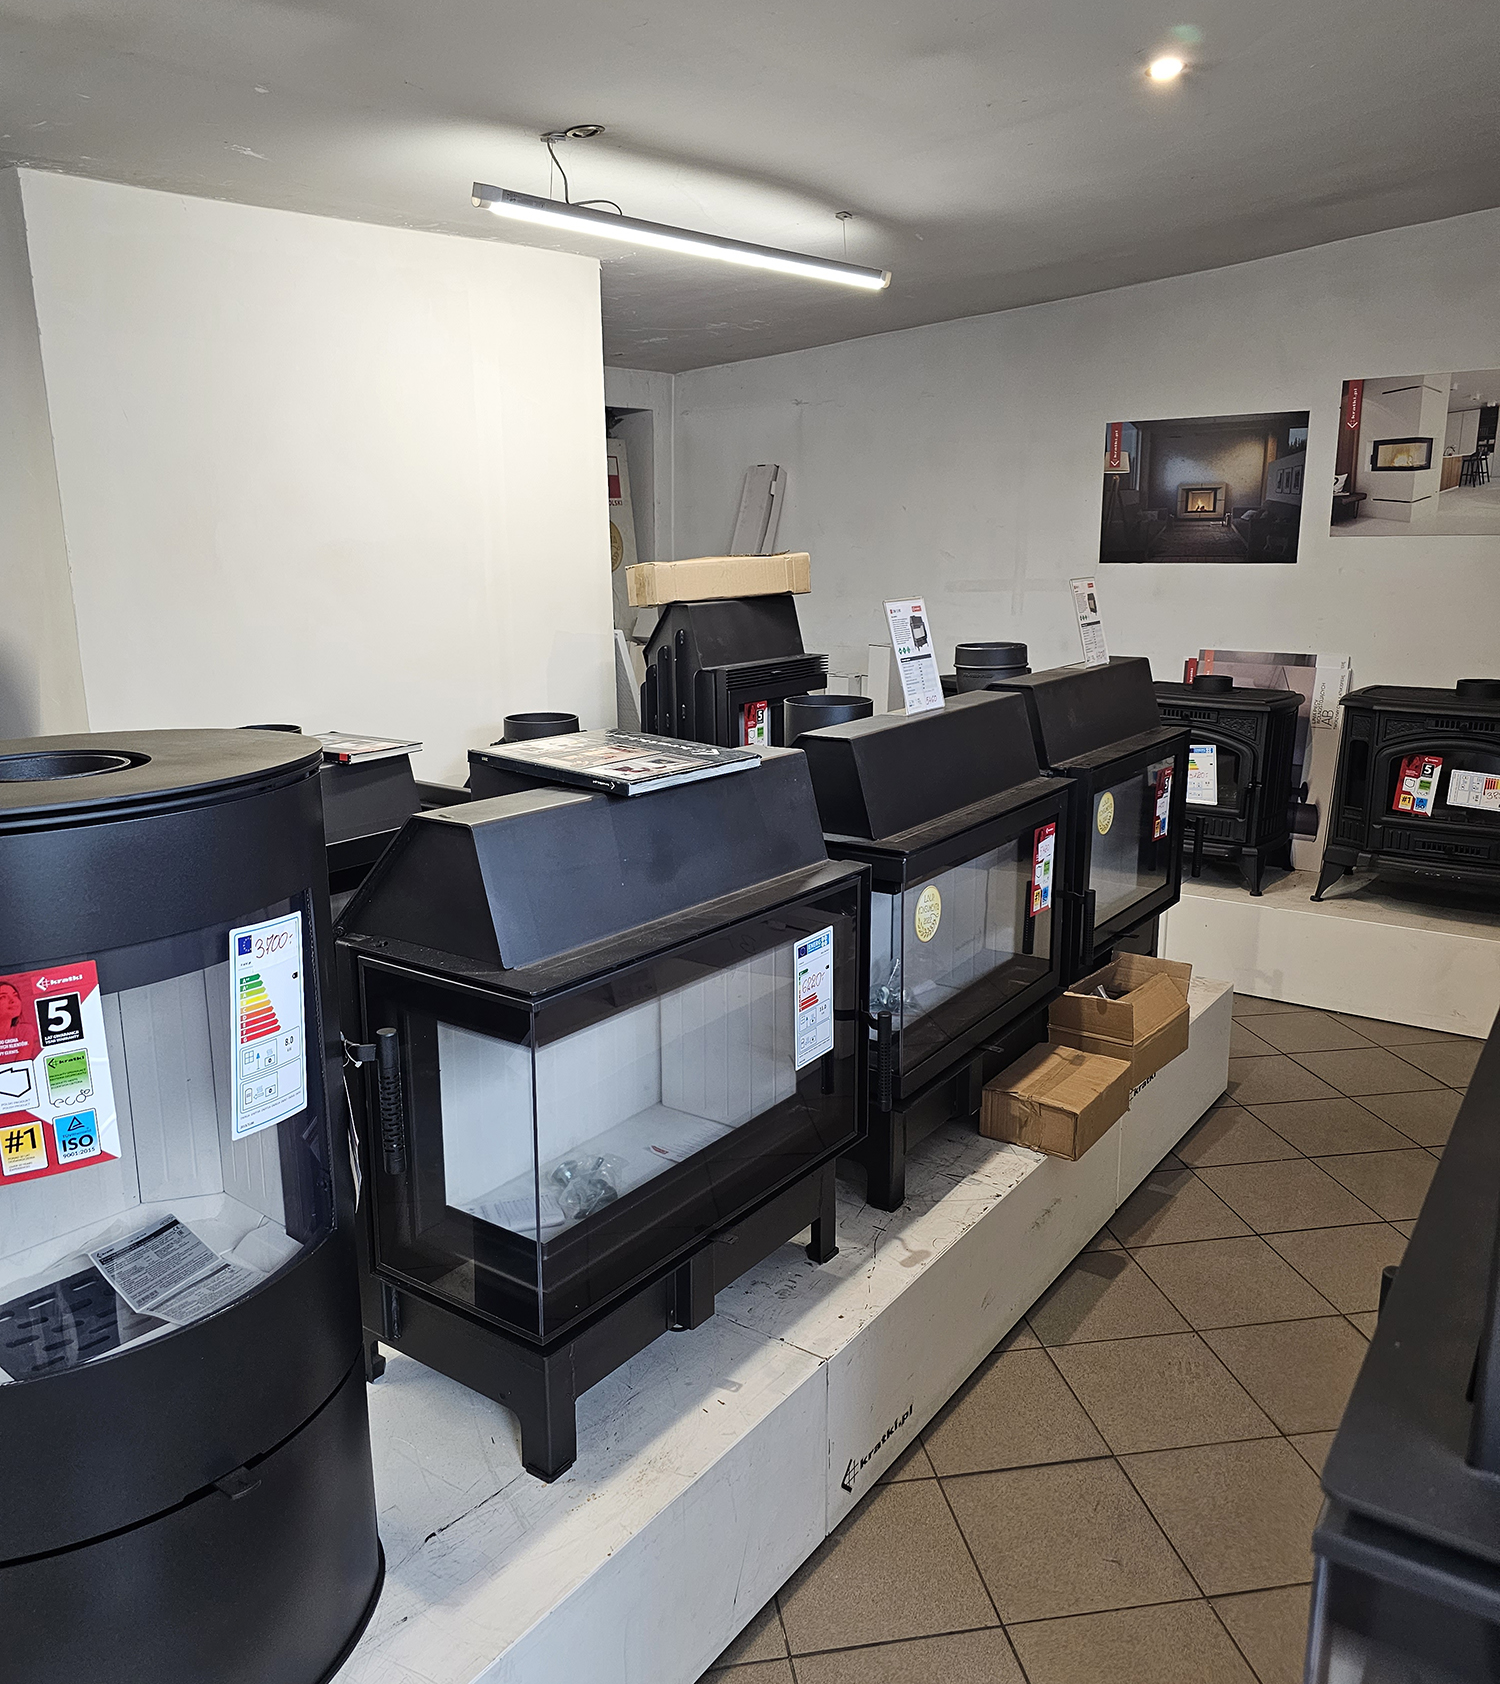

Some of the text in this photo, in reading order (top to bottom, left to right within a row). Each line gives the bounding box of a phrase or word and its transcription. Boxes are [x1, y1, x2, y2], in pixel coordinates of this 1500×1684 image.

[1424, 764, 1432, 774] 5
[48, 999, 72, 1032] 5
[5, 1127, 36, 1153] #1
[62, 1134, 94, 1152] ISO
[63, 1147, 96, 1158] 9001:2015
[860, 1404, 913, 1469] kratki.pl
